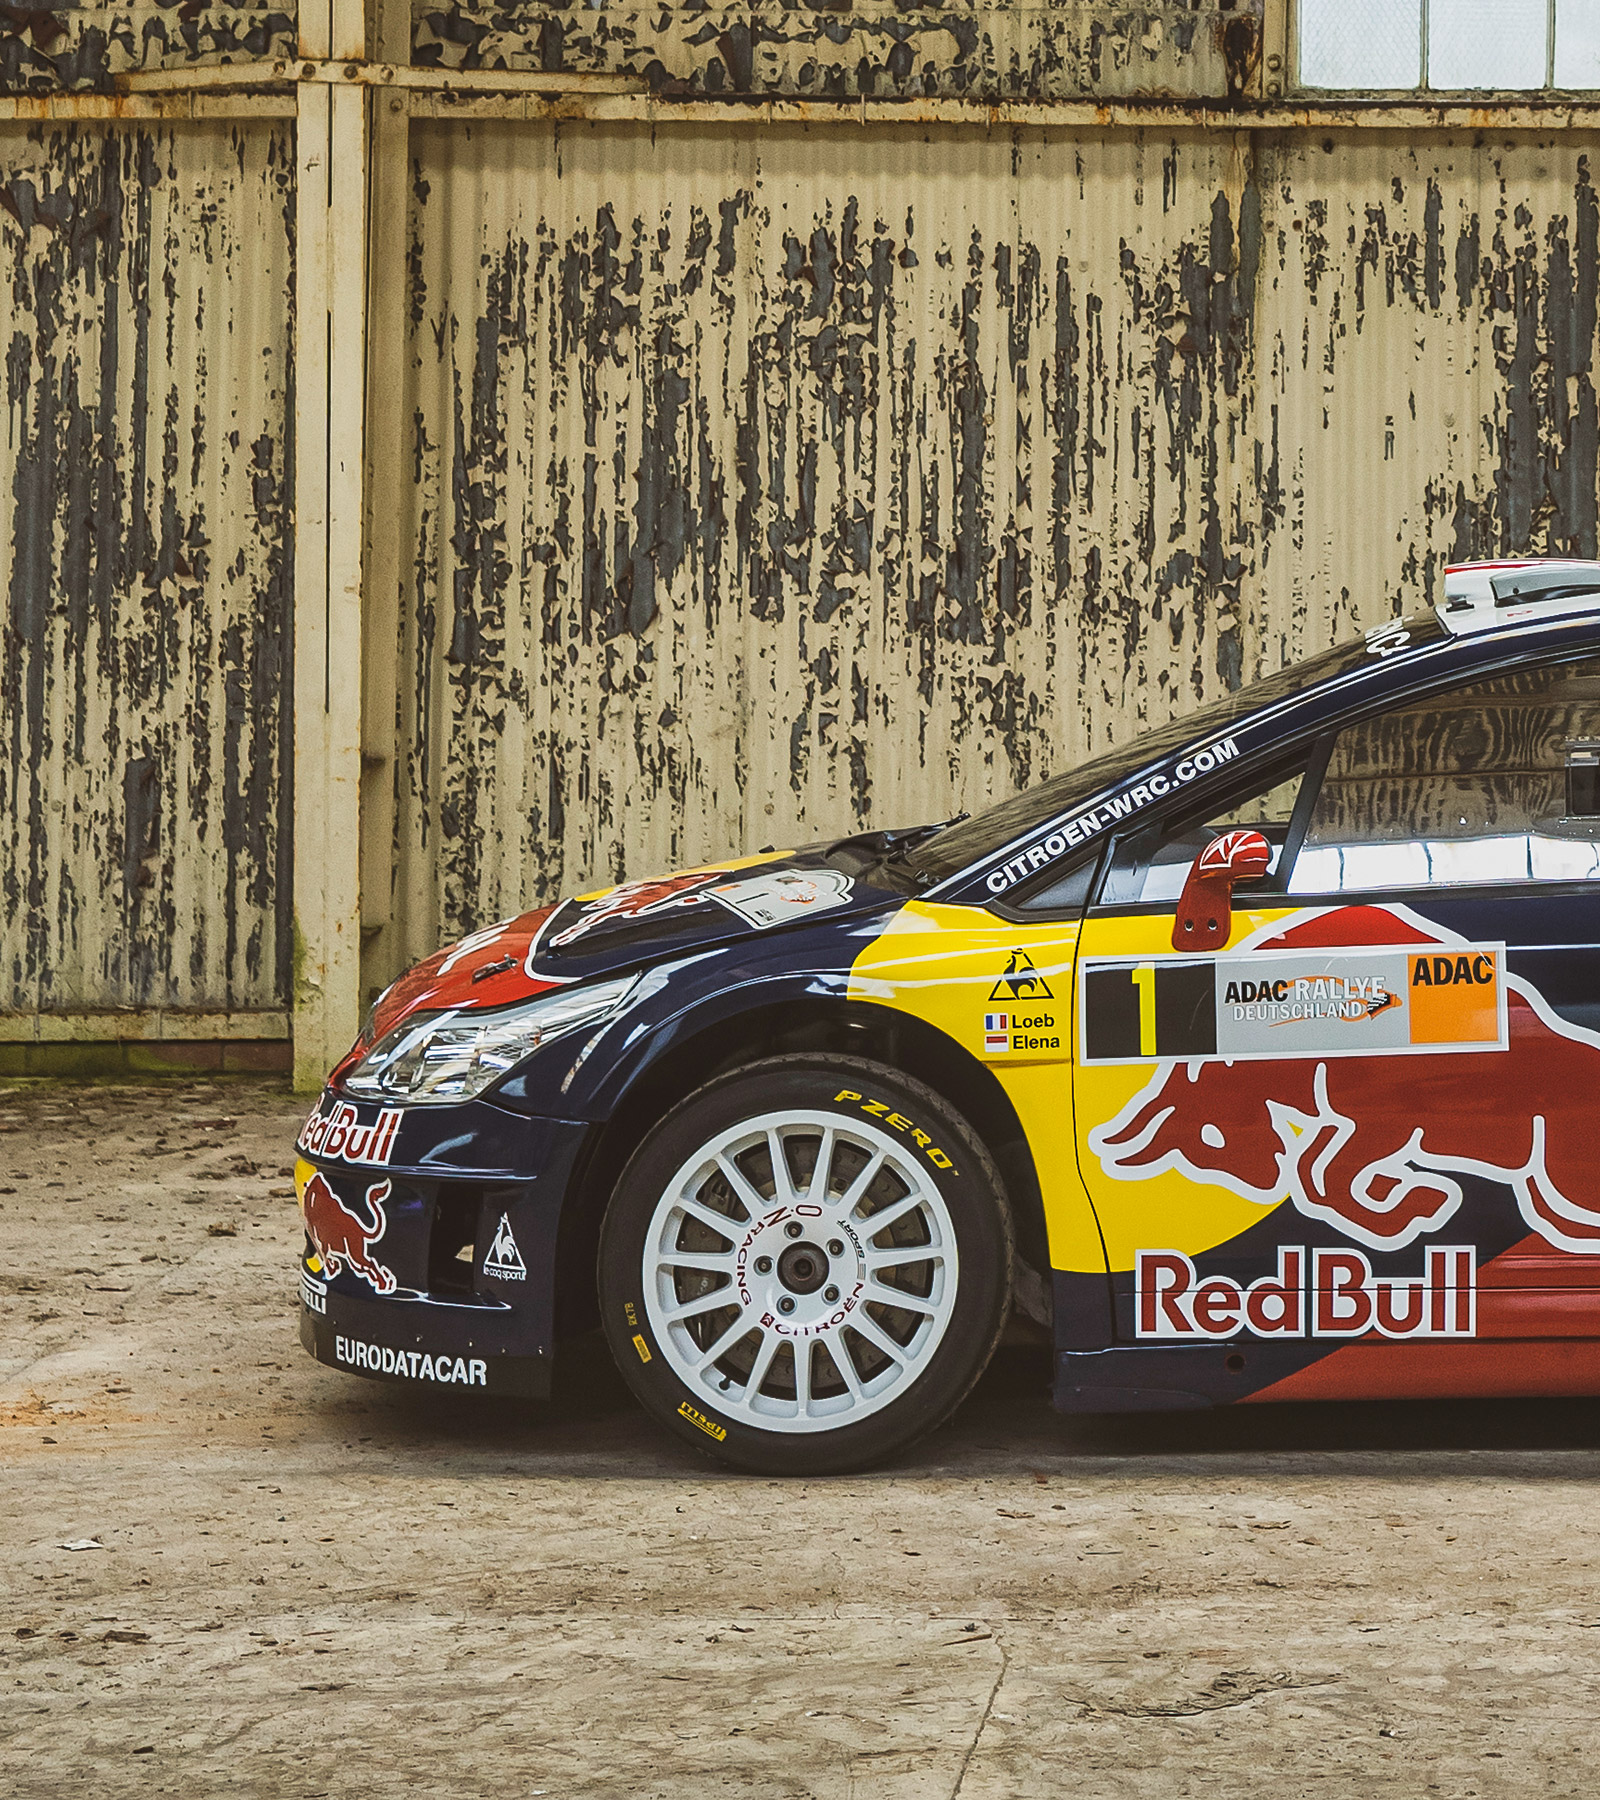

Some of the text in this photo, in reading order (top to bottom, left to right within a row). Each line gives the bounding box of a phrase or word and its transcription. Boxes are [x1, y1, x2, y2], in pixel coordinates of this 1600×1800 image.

[986, 738, 1240, 893] CITROEN-WRC.COM
[1412, 954, 1493, 987] ADAC
[1224, 975, 1386, 1005] ADAC RALLYE
[1012, 1013, 1055, 1029] Loeb
[1132, 961, 1157, 1056] 1
[1232, 1000, 1364, 1022] DEUTSCHLAND
[1013, 1035, 1060, 1049] Elena
[836, 1220, 865, 1259] SPORT
[490, 1268, 501, 1280] coq
[737, 1221, 765, 1306] RACING
[335, 1335, 487, 1386] EURODATACAR
